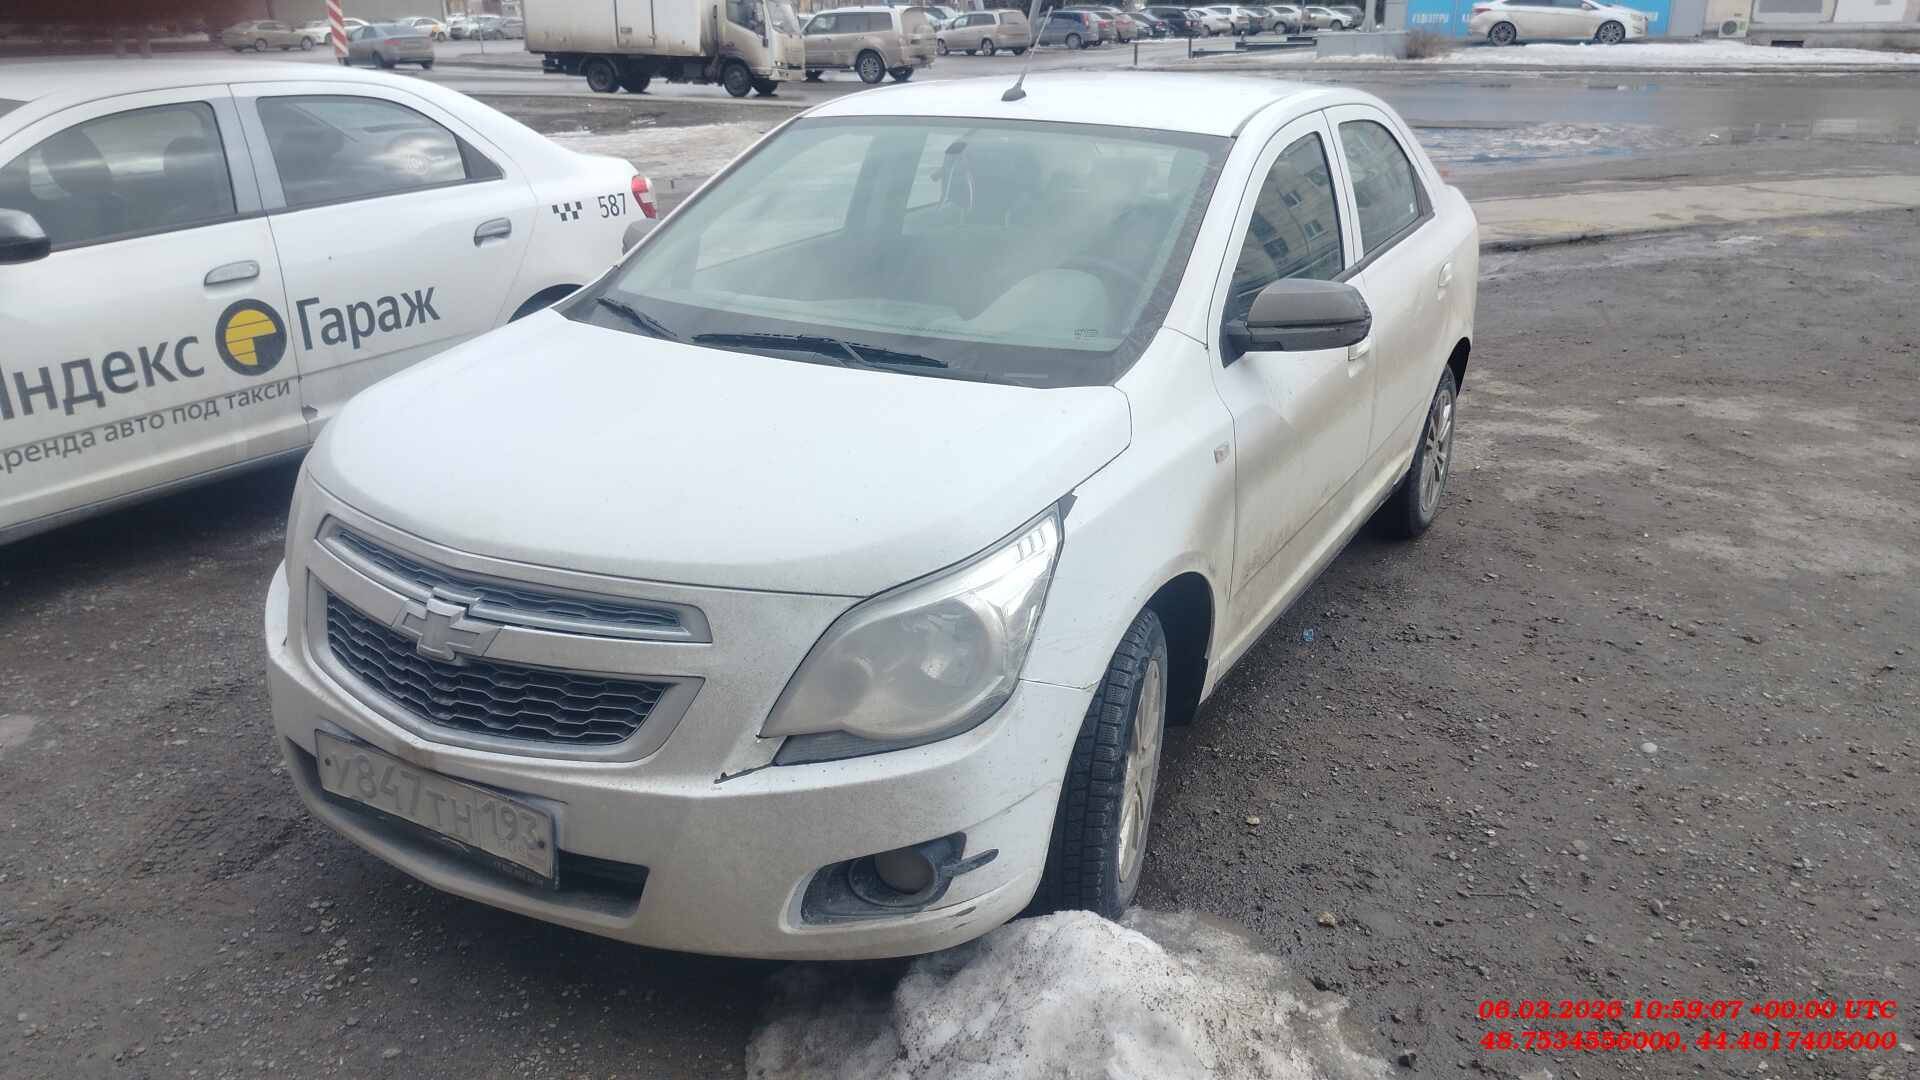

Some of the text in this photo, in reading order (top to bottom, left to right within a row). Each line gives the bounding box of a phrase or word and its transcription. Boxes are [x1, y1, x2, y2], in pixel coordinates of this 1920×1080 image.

[597, 192, 627, 218] 587
[296, 286, 440, 350] Гараж
[104, 412, 165, 443] авто
[172, 398, 220, 425] под
[226, 381, 291, 410] такси
